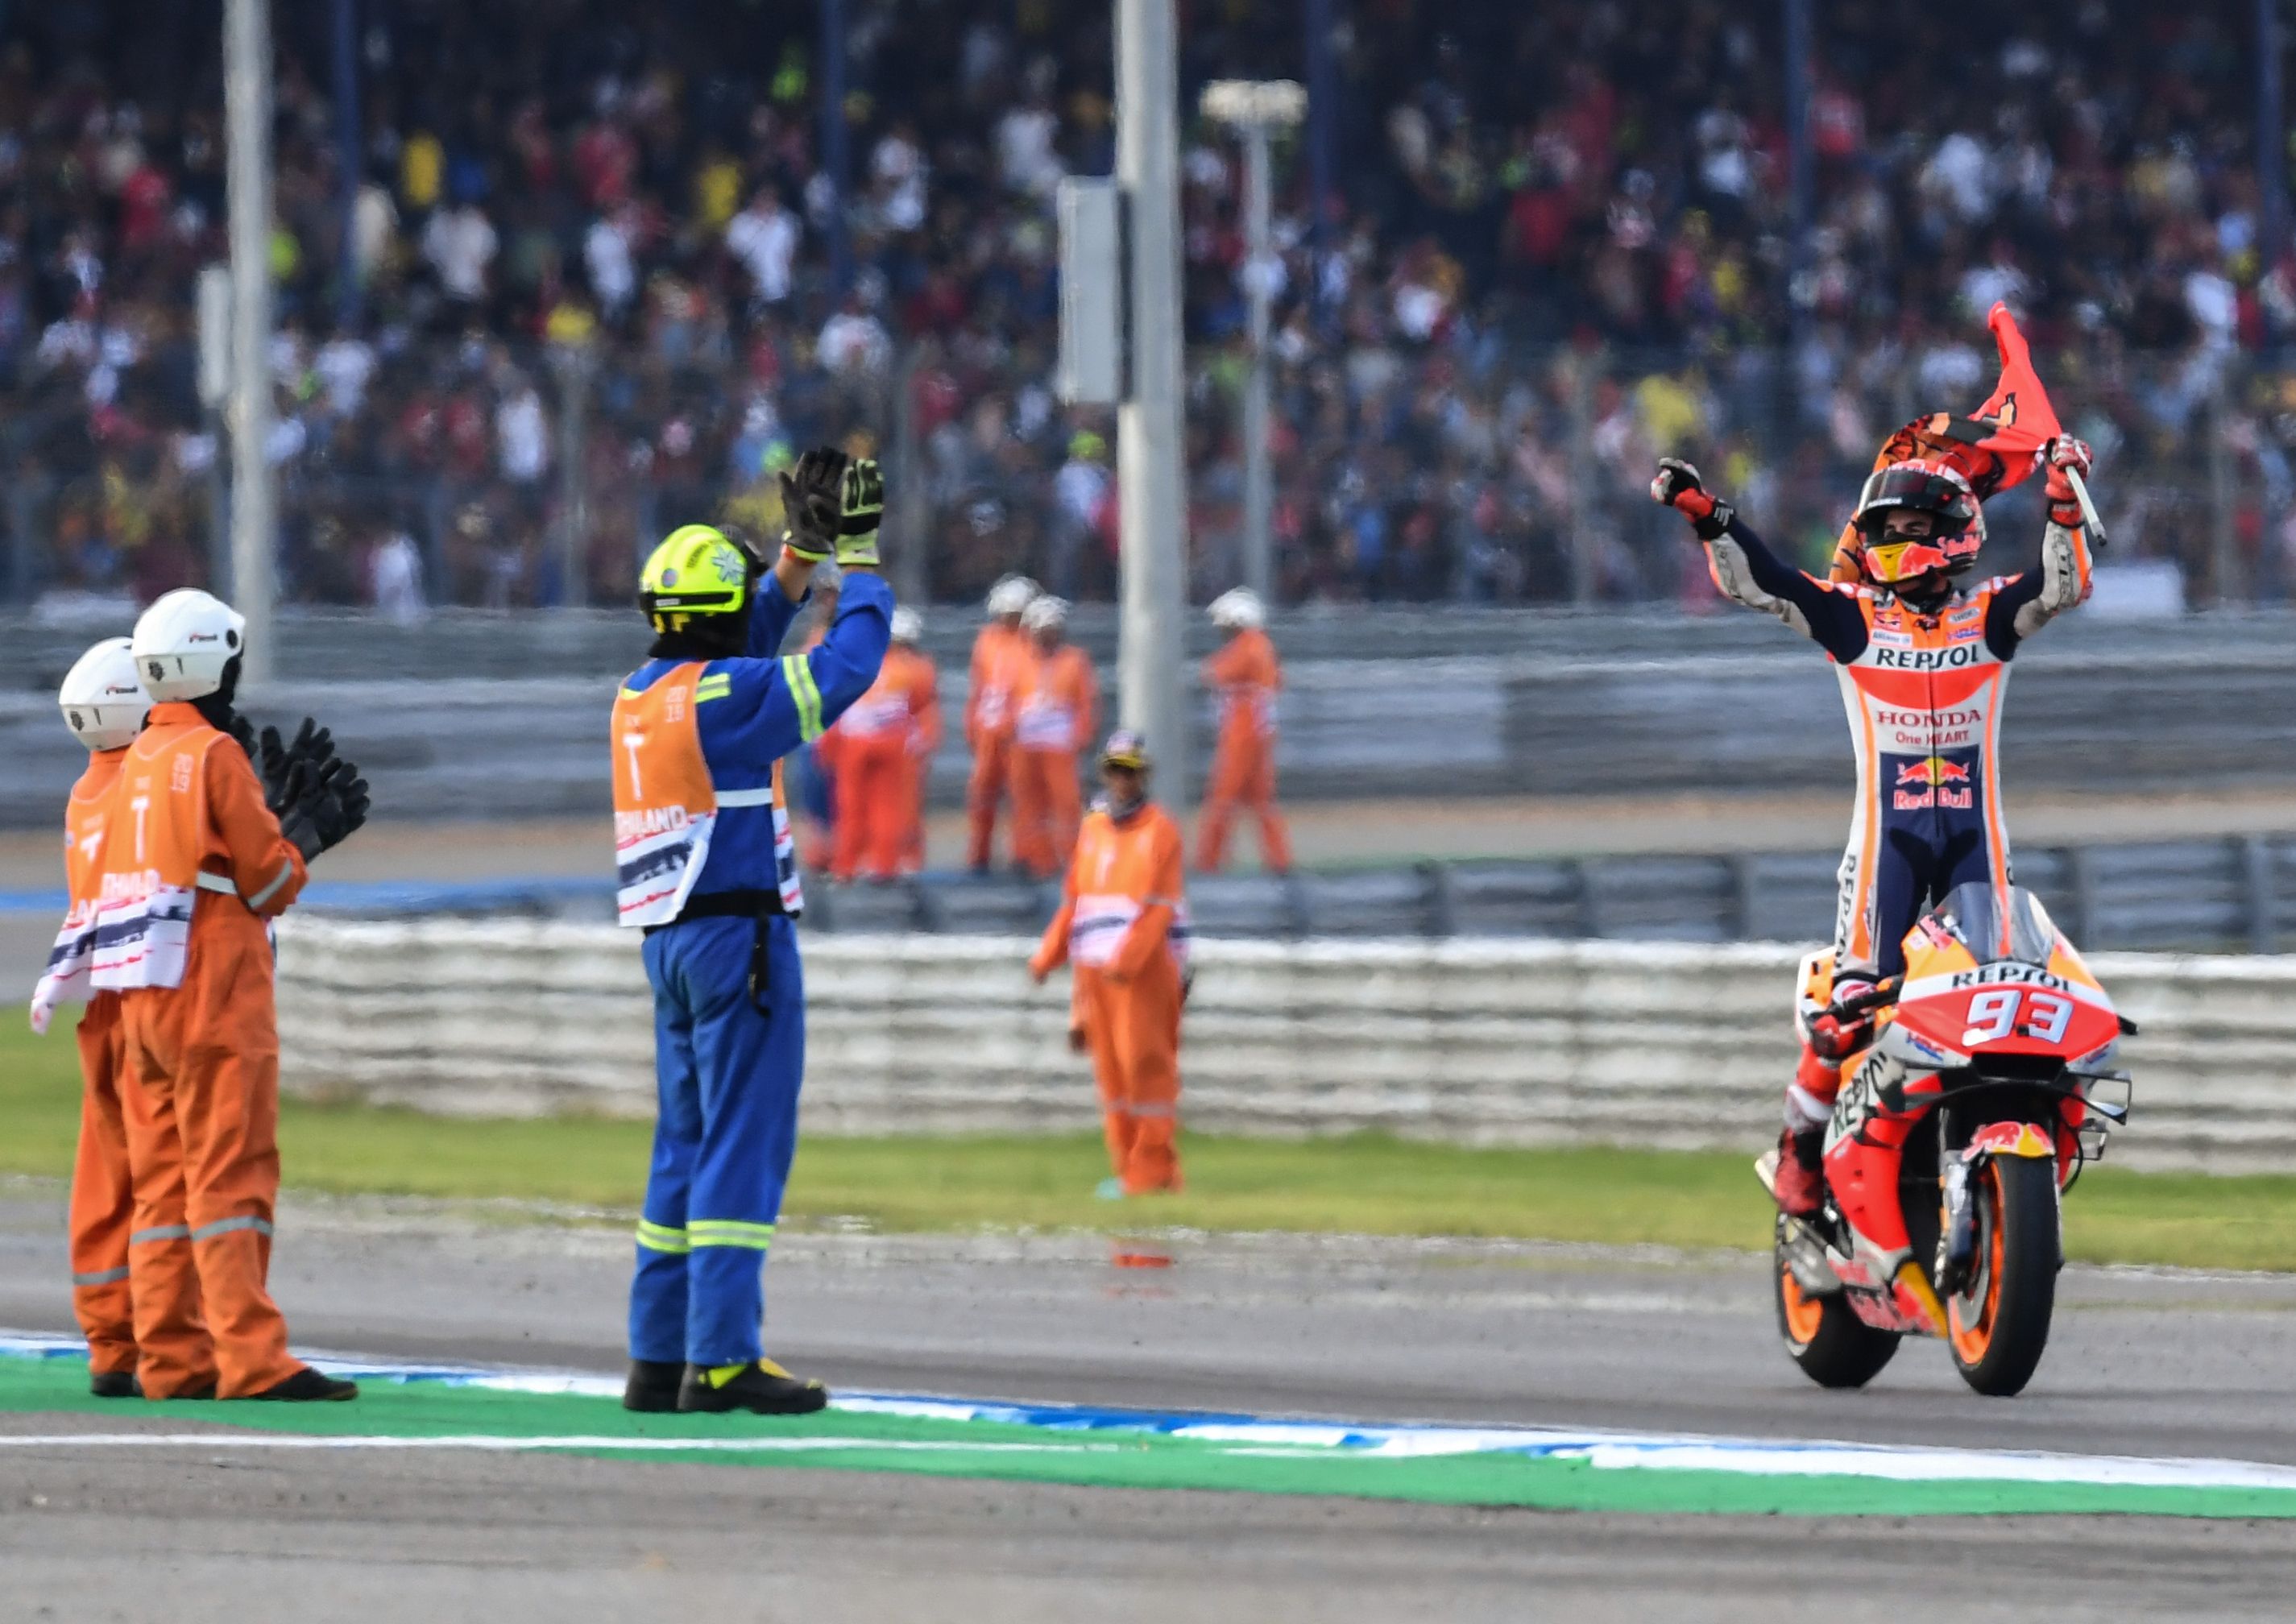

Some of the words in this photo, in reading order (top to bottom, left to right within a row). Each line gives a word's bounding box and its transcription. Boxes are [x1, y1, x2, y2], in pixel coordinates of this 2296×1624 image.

[1875, 644, 1979, 669] REPSOL
[1877, 709, 1982, 728] HONDA
[1896, 731, 1922, 745] One
[1926, 729, 1970, 745] HEART
[1893, 785, 1933, 810] Red
[1937, 786, 1973, 810] Bull
[1951, 967, 2070, 992] REPSOL
[1961, 989, 2074, 1047] 93
